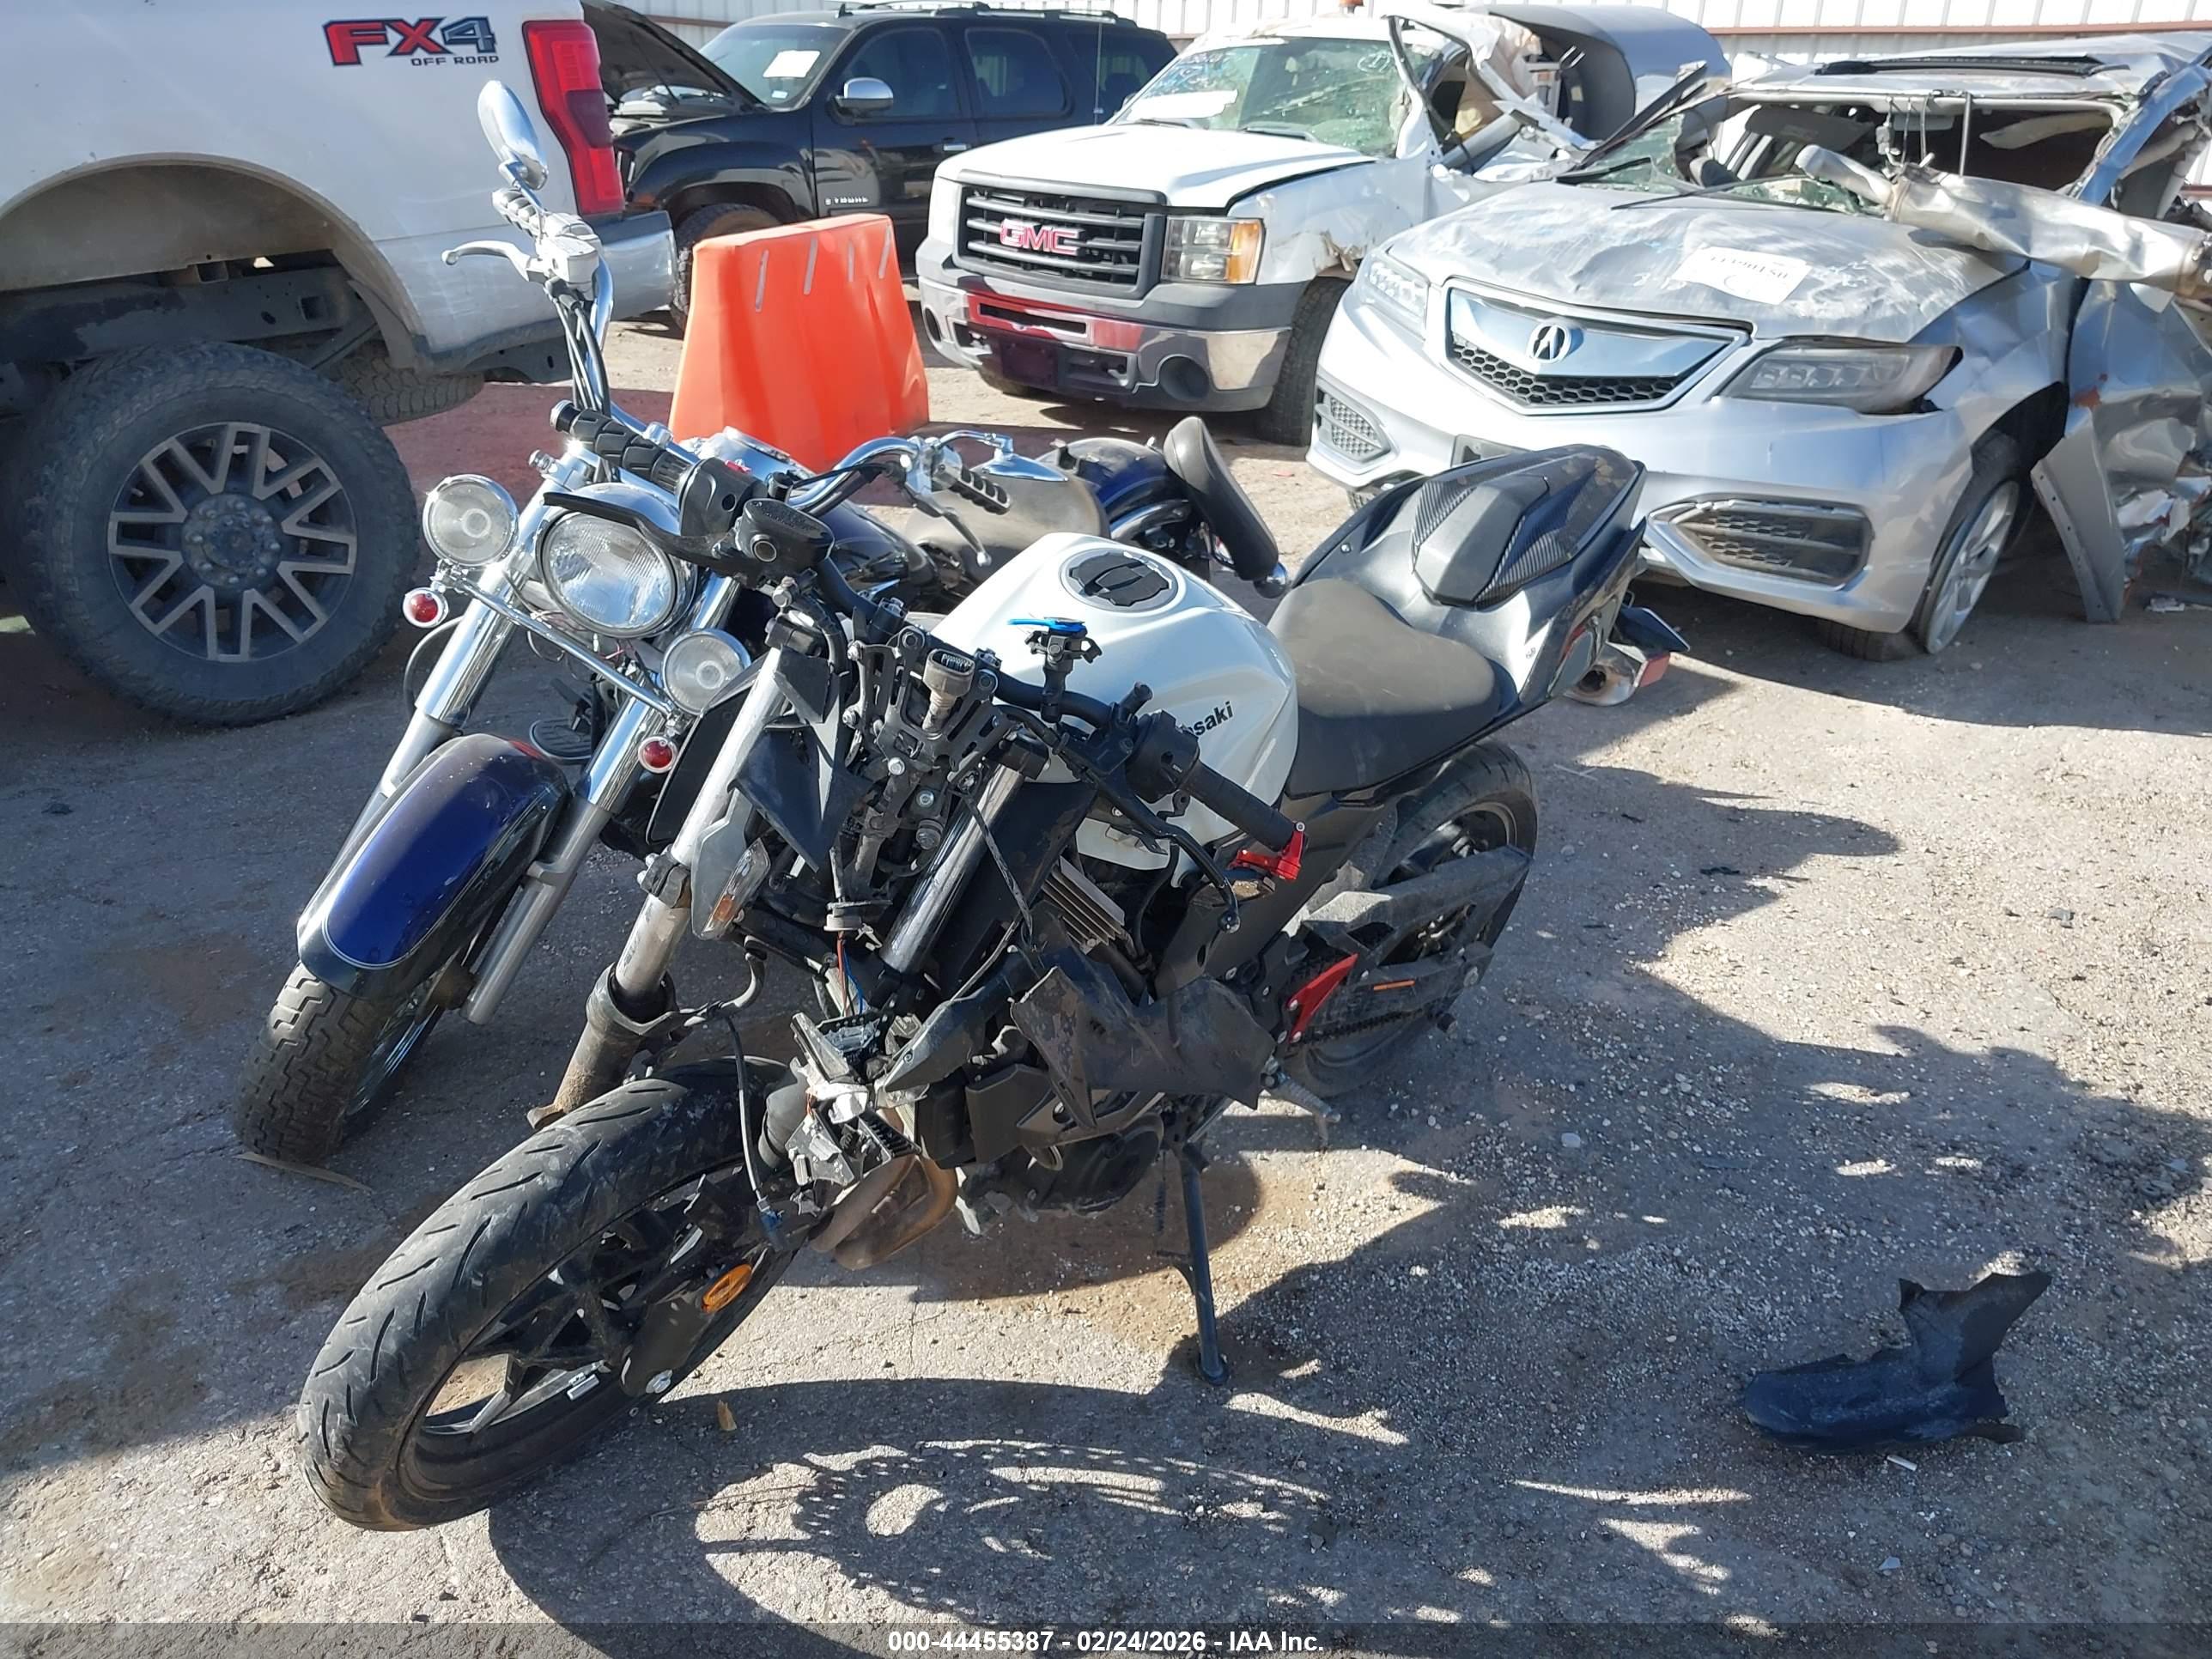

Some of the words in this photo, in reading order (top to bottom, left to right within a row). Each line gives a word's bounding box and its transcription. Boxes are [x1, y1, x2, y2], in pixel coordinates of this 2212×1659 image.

[322, 16, 497, 66] FX4
[410, 57, 447, 66] OFF
[453, 55, 499, 65] ROAD
[1000, 218, 1083, 256] GMC
[1188, 701, 1233, 736] saki
